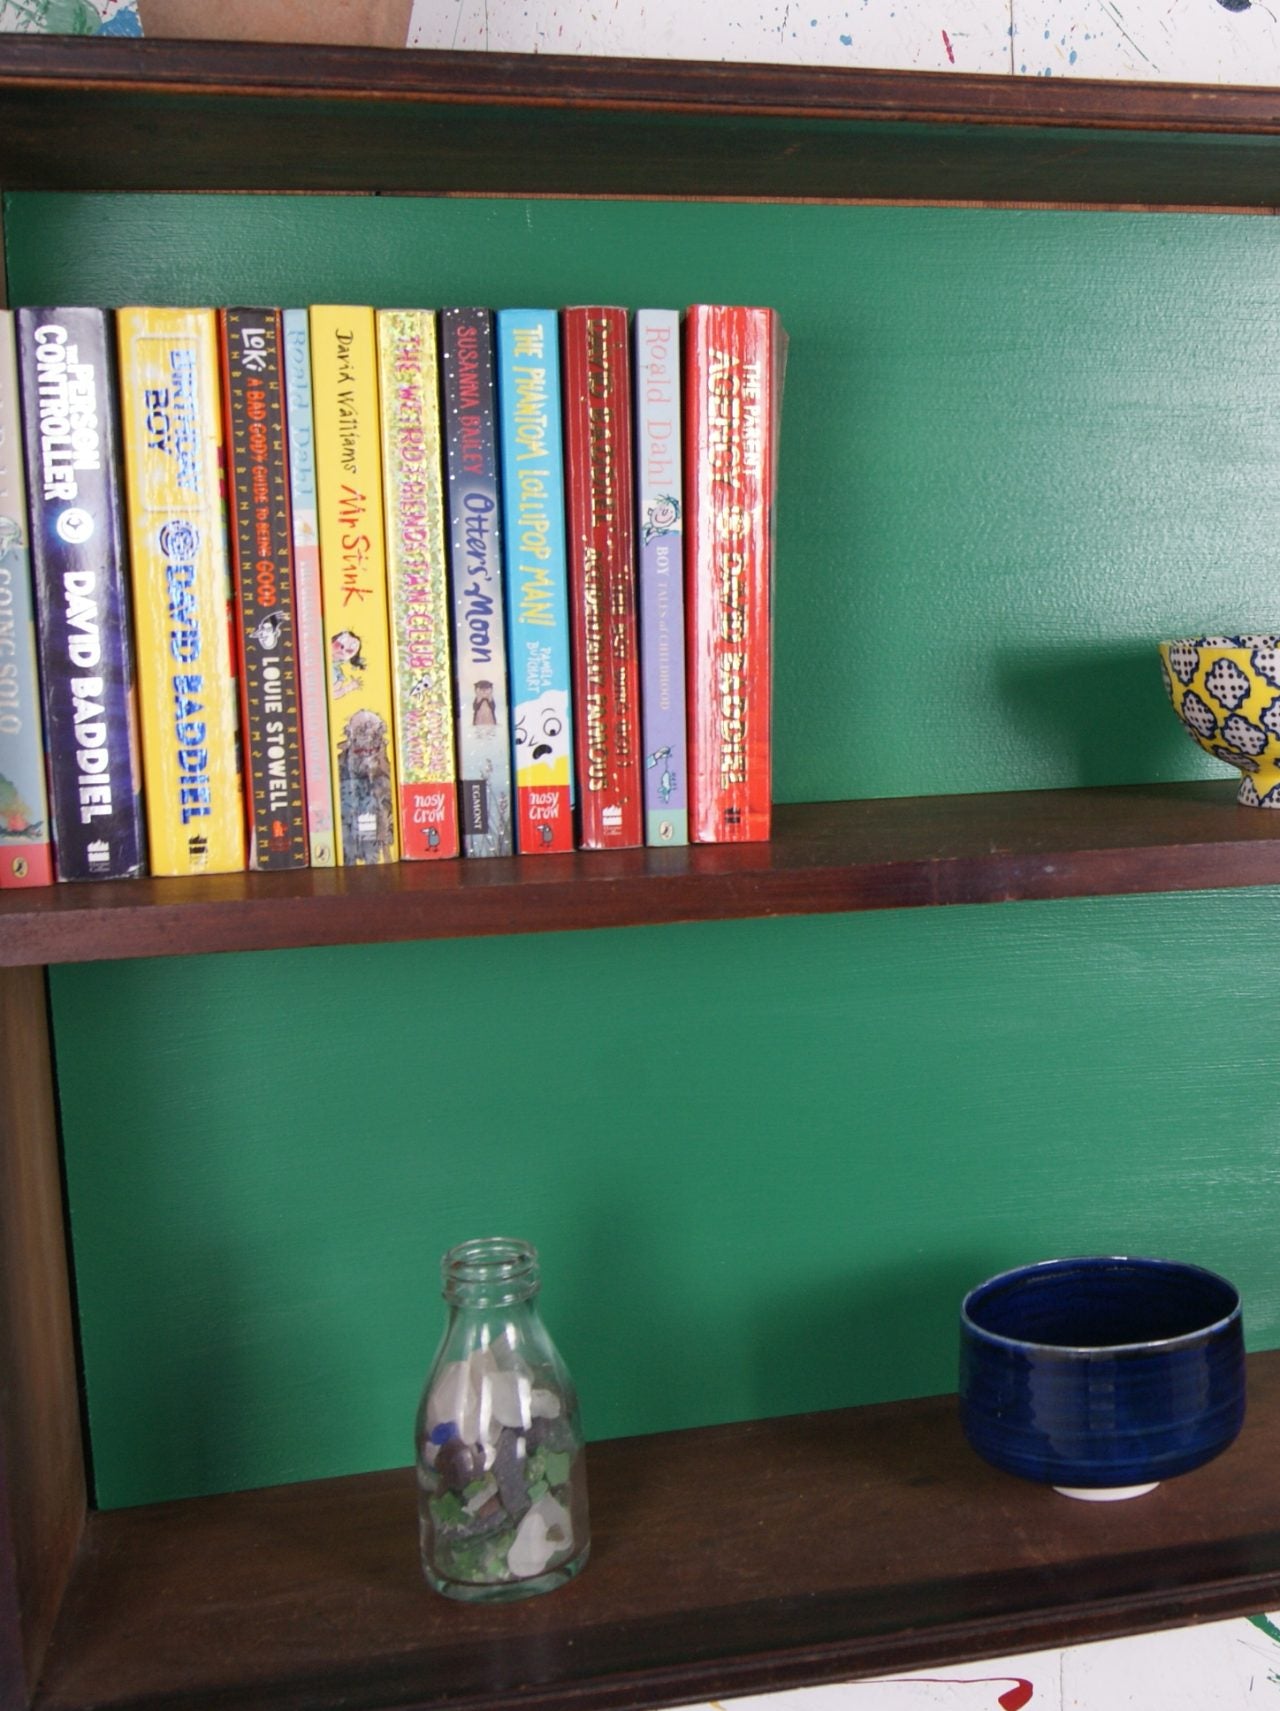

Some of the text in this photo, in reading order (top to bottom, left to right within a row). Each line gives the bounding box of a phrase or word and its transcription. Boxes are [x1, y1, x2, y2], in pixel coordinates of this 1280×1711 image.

[288, 329, 310, 409] Roald
[512, 324, 544, 359] THE
[34, 324, 78, 501] CONTROLLER
[67, 364, 100, 470] PERSON
[145, 388, 172, 455] BOY
[170, 350, 200, 493] BIRTHDAY
[246, 388, 266, 421] BAD
[335, 328, 361, 474] David Walliams
[400, 385, 427, 462] WEIRD
[457, 326, 484, 475] SUSANNA BAILEY
[512, 366, 549, 461] PHANTOM
[587, 319, 616, 527] DAVID BADDIEL
[645, 326, 673, 487] Roald Dahl
[707, 346, 741, 489] AGENCY
[742, 361, 761, 480] THE PARENT
[252, 465, 270, 503] GUIDE
[256, 560, 276, 607] GOOD
[338, 484, 373, 607] Mr Stink
[656, 546, 670, 576] BOY
[407, 612, 435, 668] CLUB
[463, 582, 494, 663] Moon
[518, 565, 557, 628] MAN!
[0, 662, 22, 735] SOLO
[63, 571, 112, 824] DAVID BADDIEL
[166, 565, 211, 825] DAVID BADDIEL
[526, 641, 541, 693] BUTCHART
[540, 647, 552, 687] PAMELA
[719, 552, 749, 791] DAVID BADDIEL
[262, 656, 288, 812] LOUIE STOWELL
[587, 692, 608, 791] FAMOUS
[471, 784, 483, 830] EGMONT
